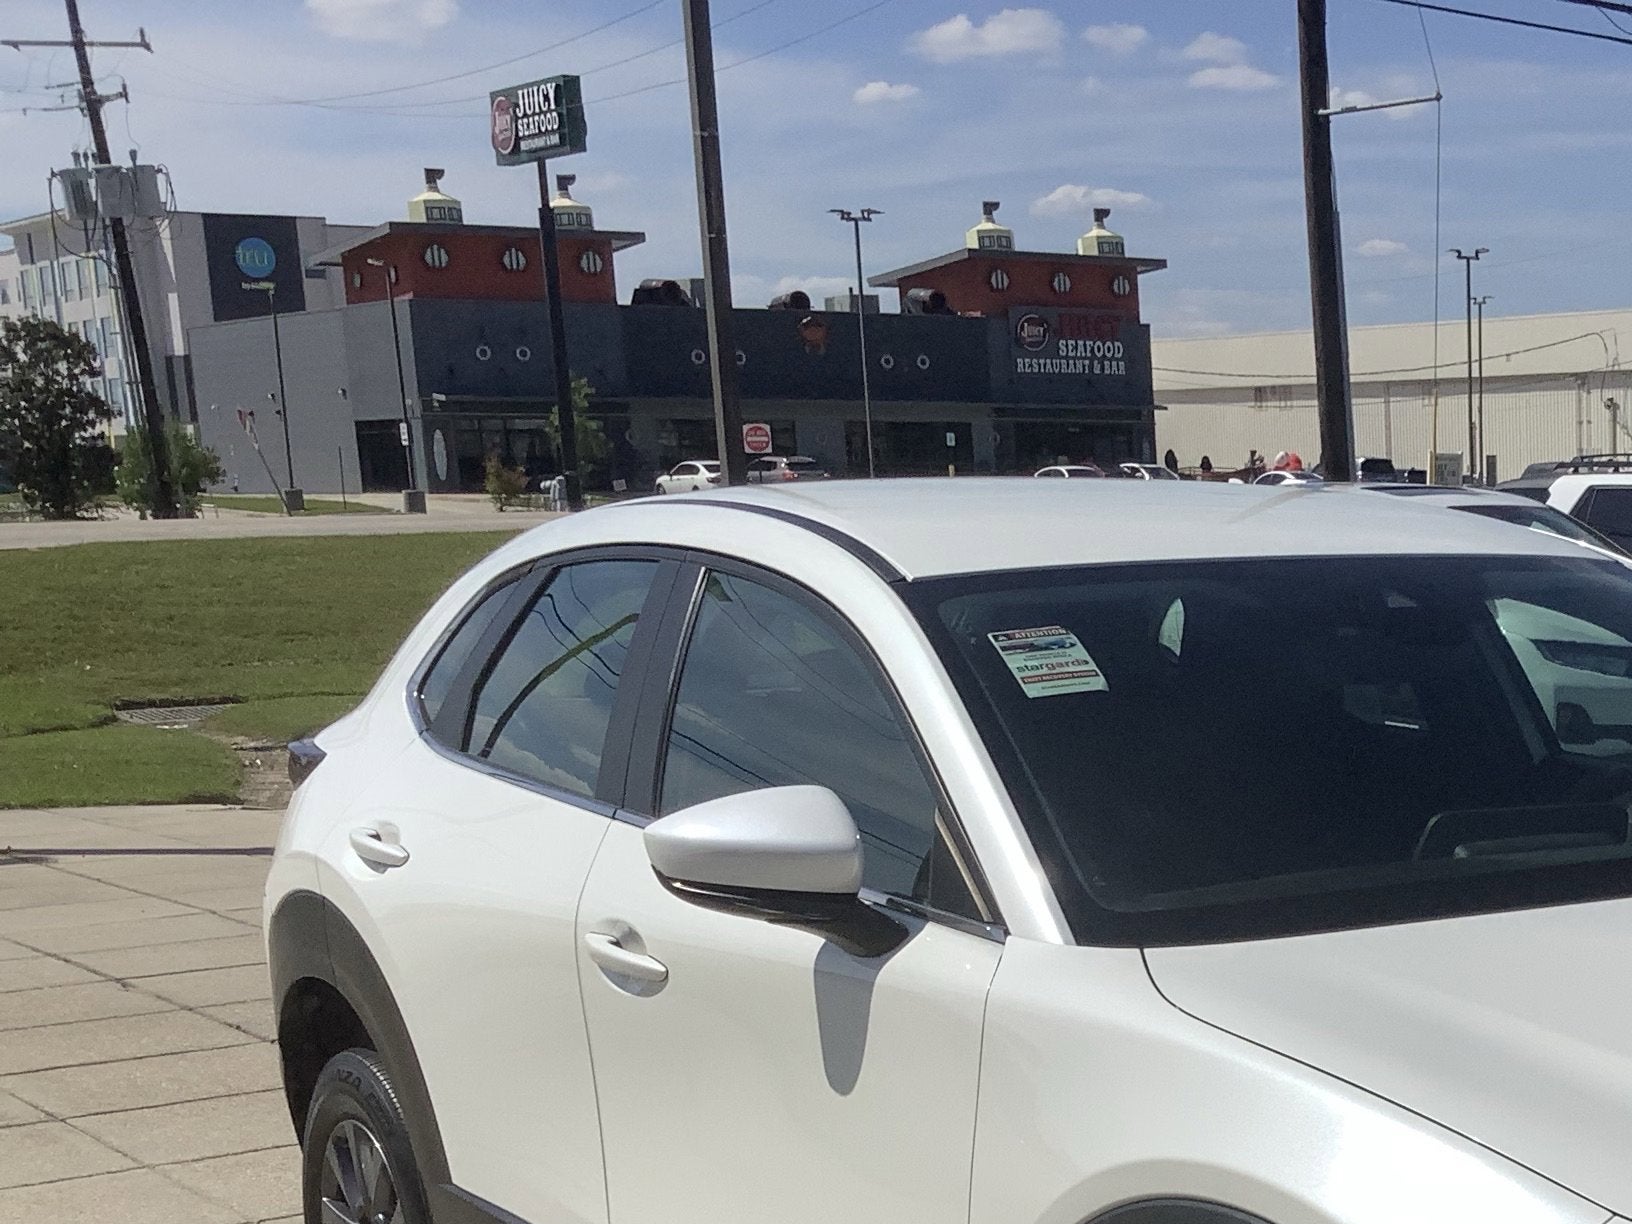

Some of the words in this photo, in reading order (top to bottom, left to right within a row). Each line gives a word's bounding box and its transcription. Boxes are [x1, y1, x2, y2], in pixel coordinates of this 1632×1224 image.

[516, 82, 556, 117] JUICY
[517, 111, 559, 137] SEAFOOD
[1059, 340, 1124, 358] SEAFOOD
[1017, 358, 1090, 373] RESTAURANT
[1093, 361, 1101, 373] &
[1104, 361, 1126, 375] BAR
[1014, 628, 1067, 639] ATTENTION
